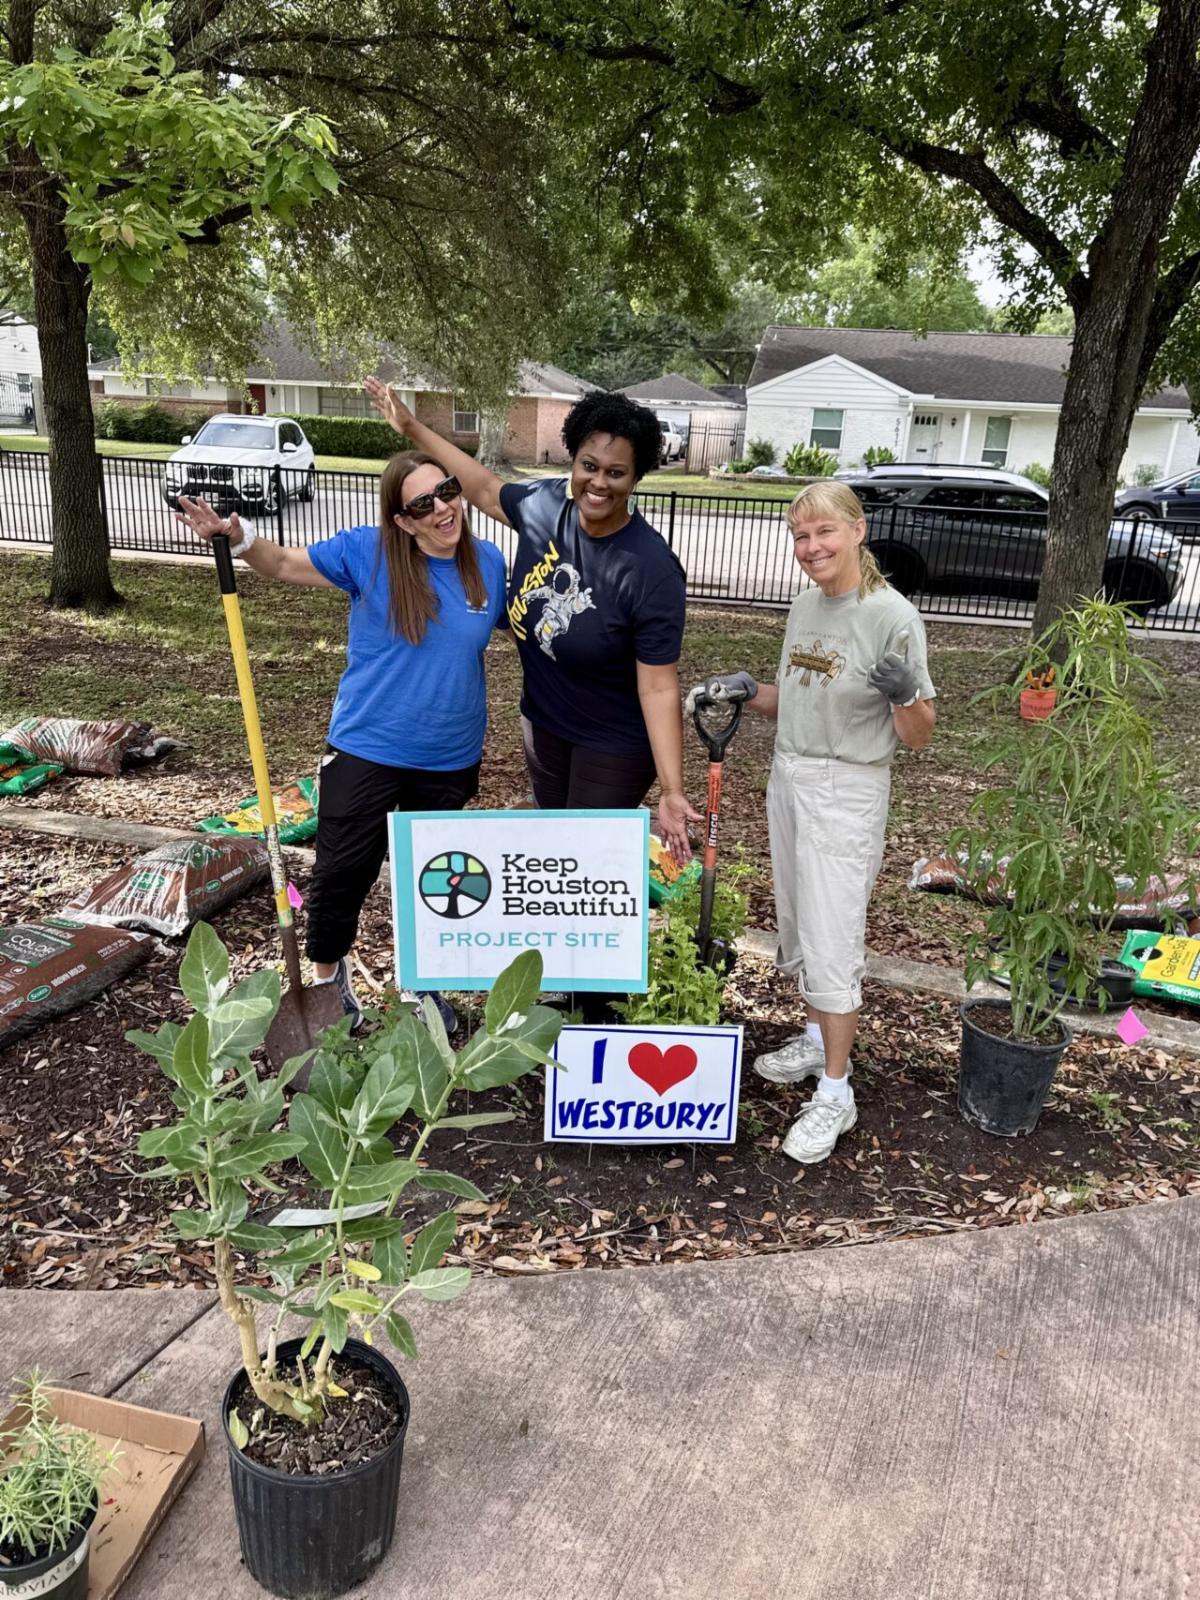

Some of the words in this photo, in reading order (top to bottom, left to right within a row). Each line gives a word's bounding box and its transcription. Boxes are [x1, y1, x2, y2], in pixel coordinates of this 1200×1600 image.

[502, 853, 578, 877] Keep
[502, 875, 631, 895] Houston
[502, 897, 639, 917] Beautiful
[10, 934, 56, 954] COLOR
[439, 931, 558, 947] PROJECT
[565, 932, 620, 948] SITE
[592, 1038, 608, 1084] I
[558, 1098, 727, 1131] WESTBURY!
